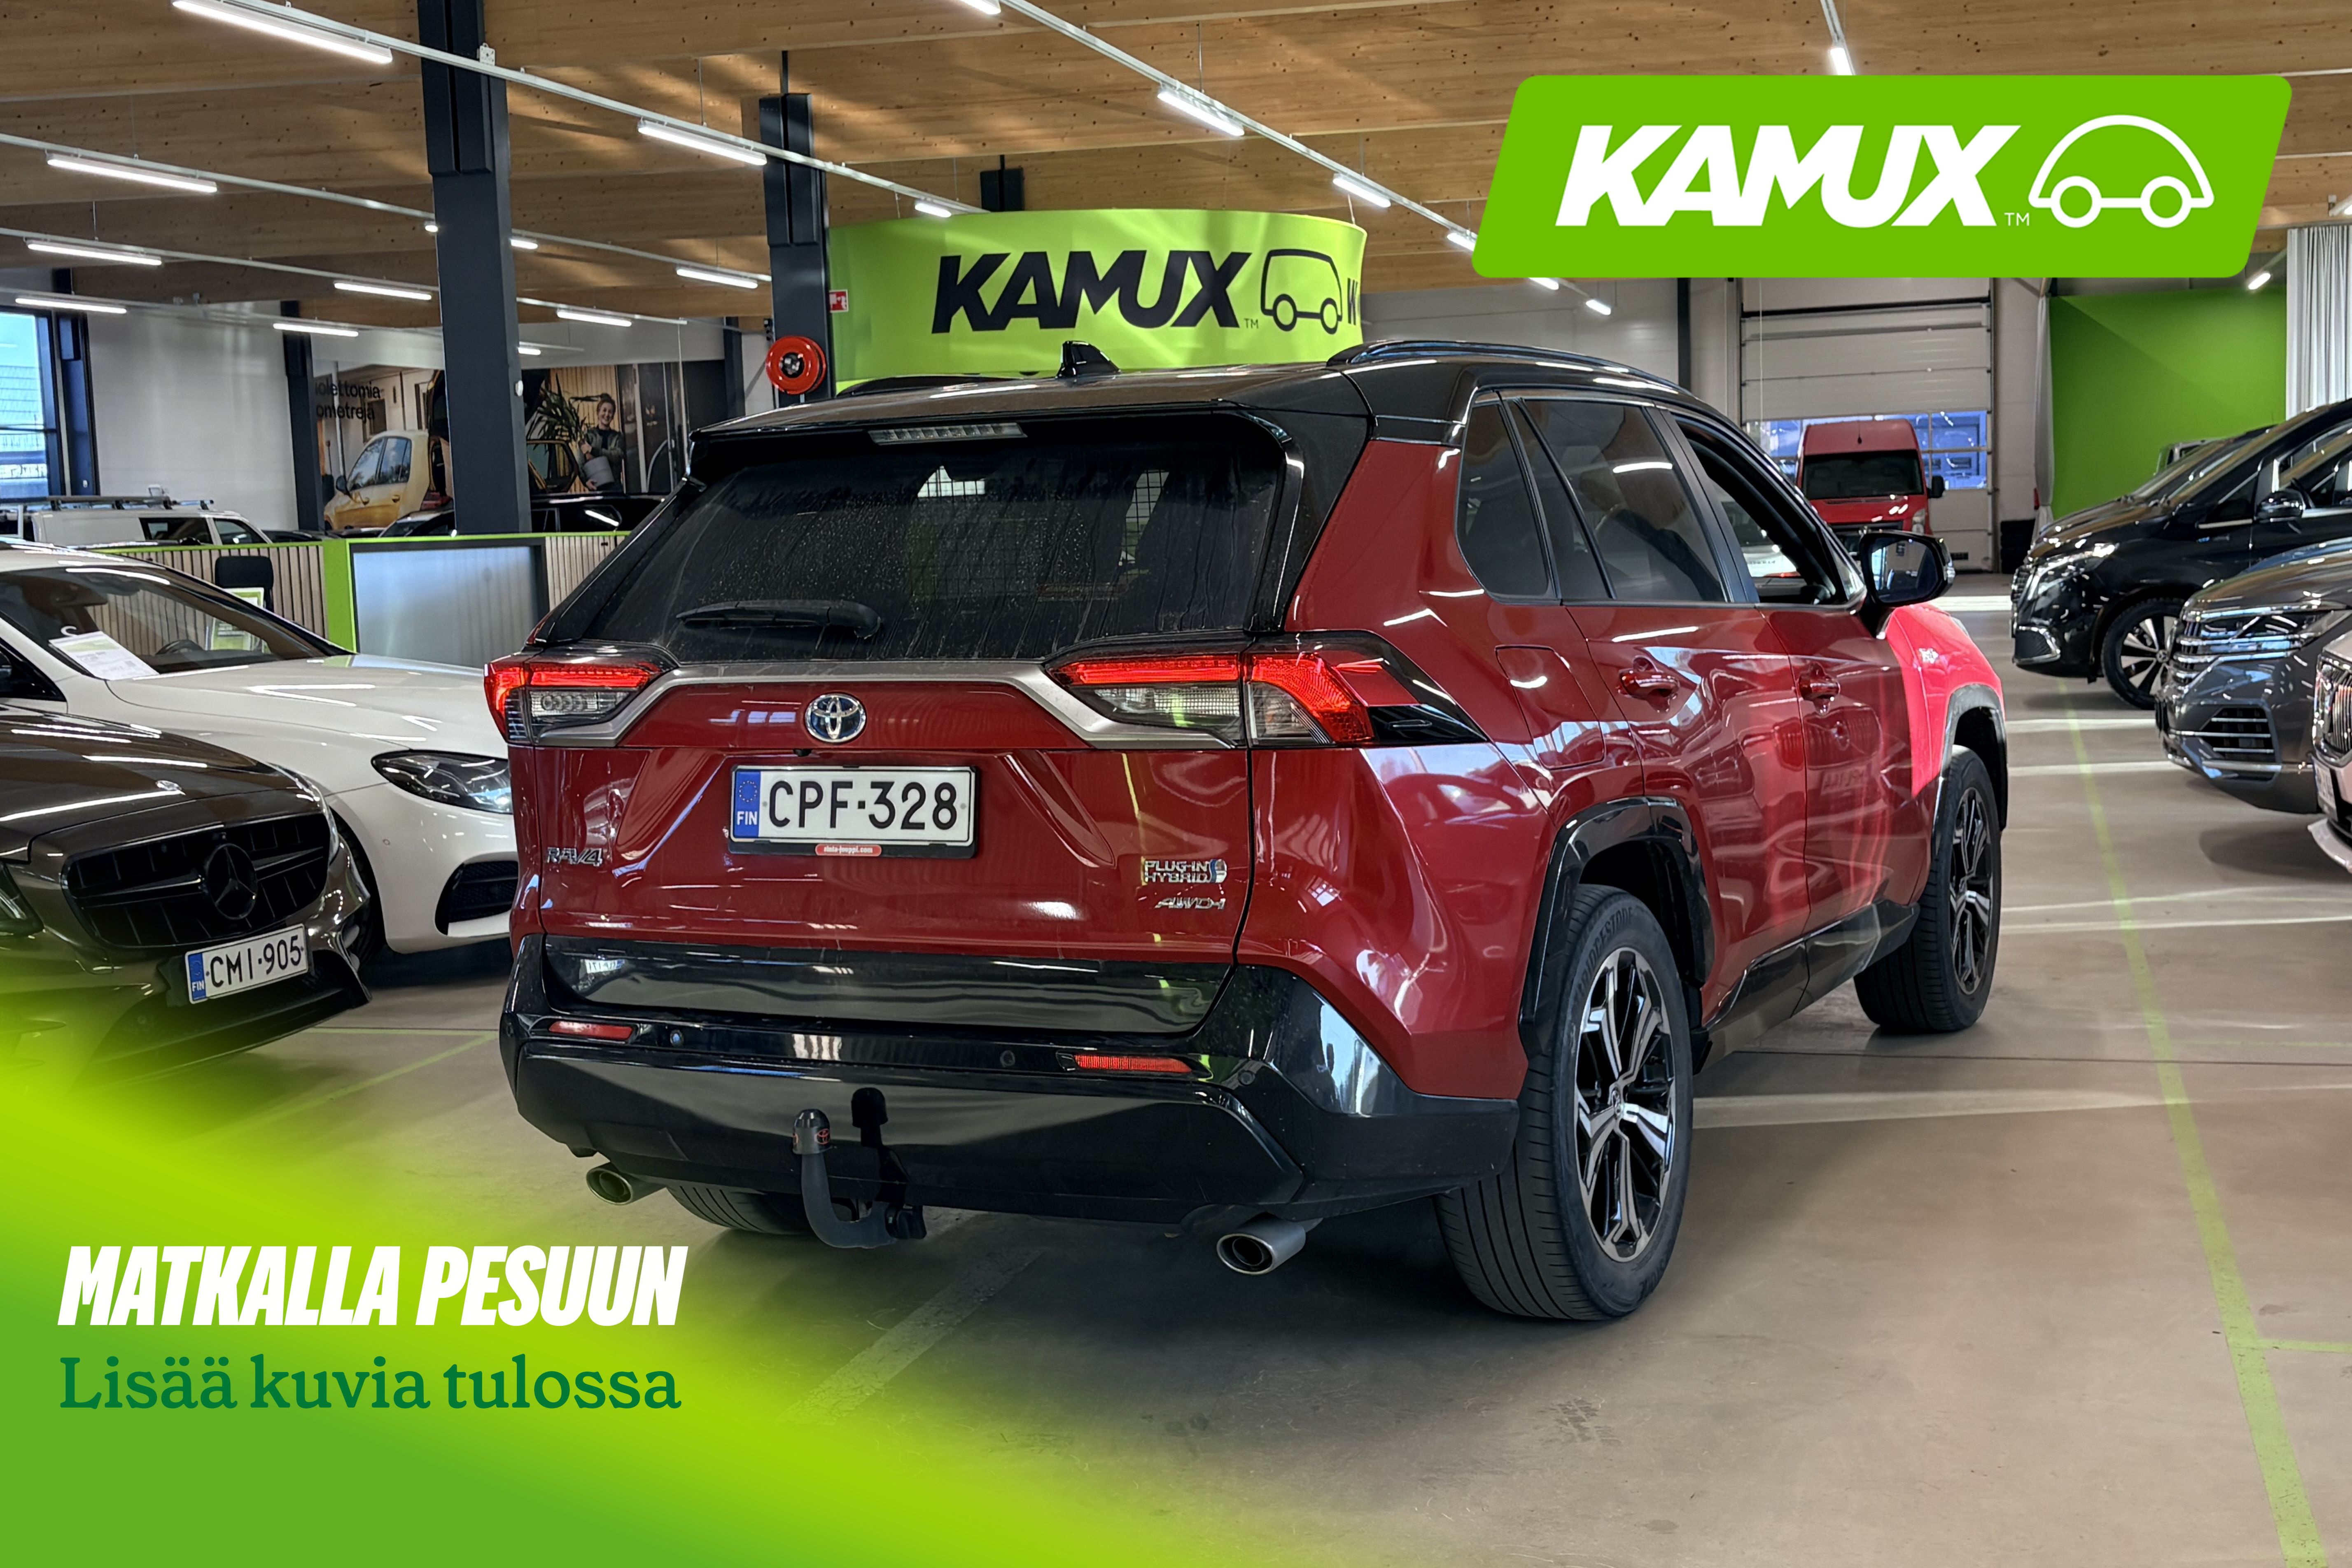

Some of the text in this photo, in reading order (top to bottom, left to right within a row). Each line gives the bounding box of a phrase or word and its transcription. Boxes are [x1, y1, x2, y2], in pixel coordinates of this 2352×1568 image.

[931, 250, 1252, 334] KAMUX
[769, 781, 957, 830] CPF-328
[737, 811, 757, 825] FIN
[547, 847, 603, 867] RAV4
[1144, 860, 1210, 873] PLUG-IN
[1144, 872, 1209, 883] HYBRID
[210, 934, 302, 988] CMI-905
[191, 980, 205, 992] FIN
